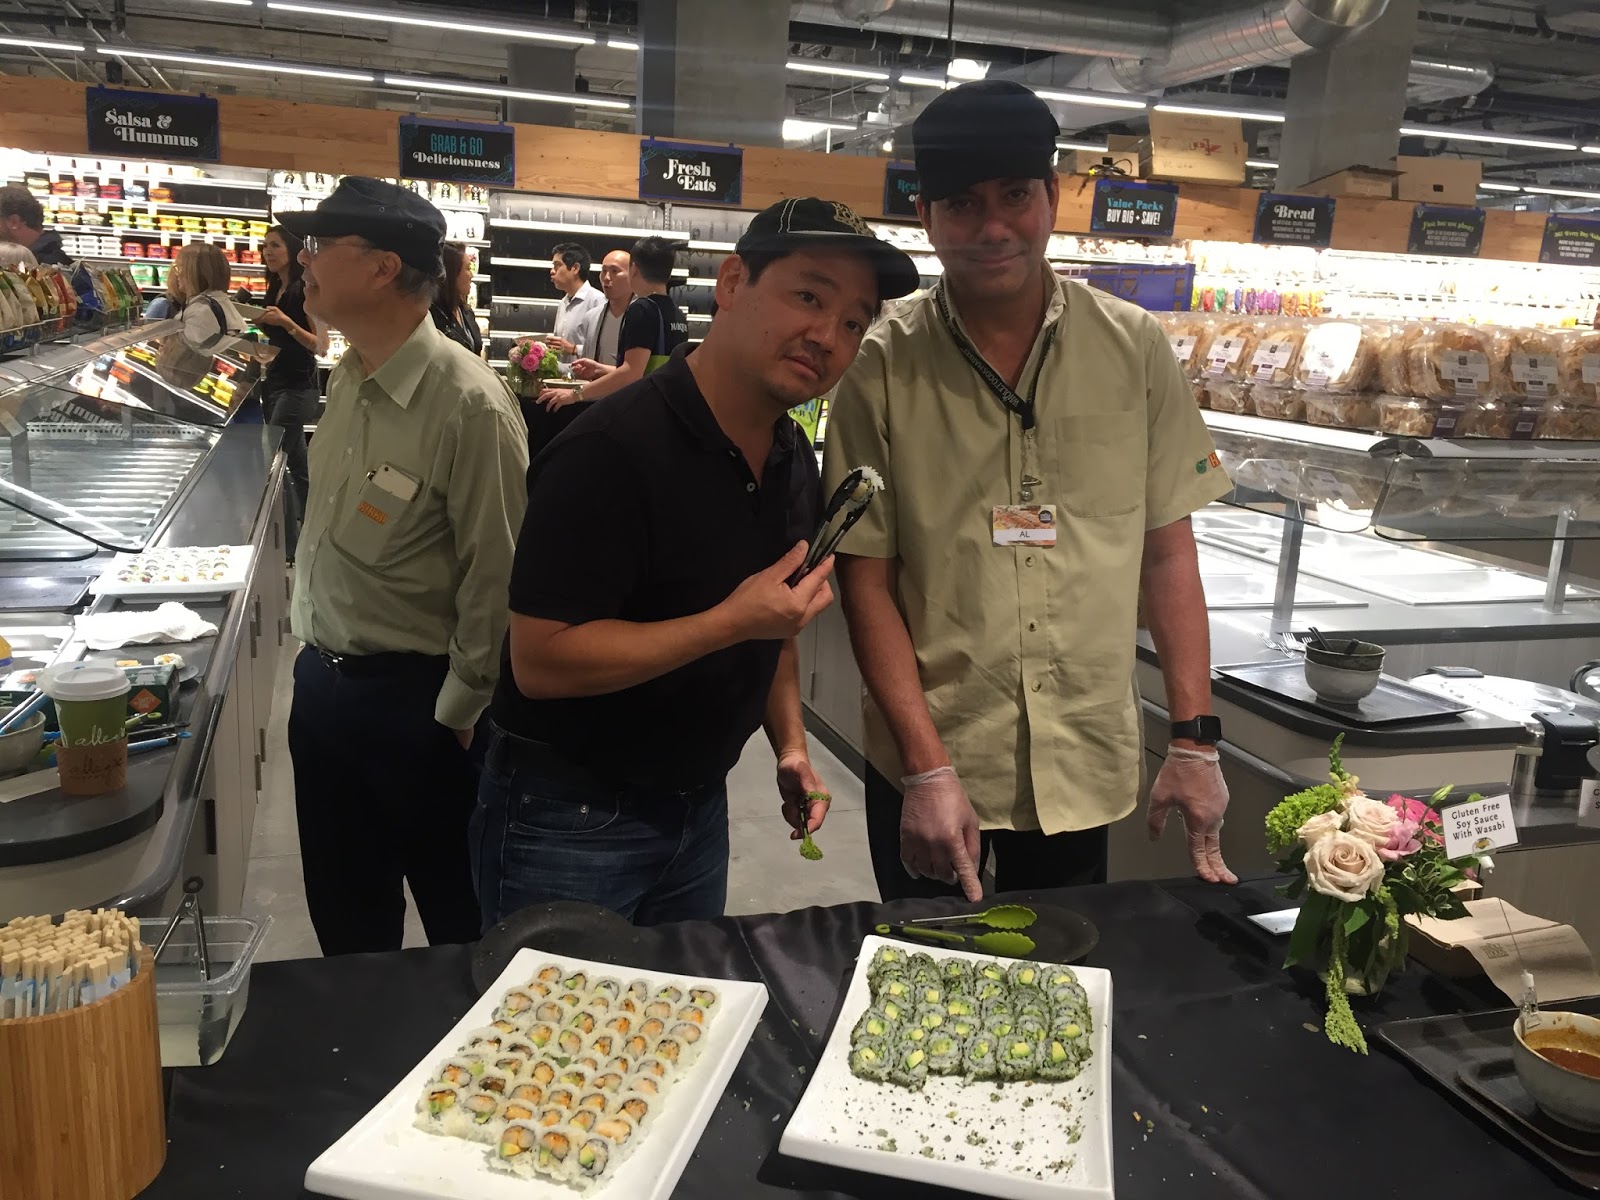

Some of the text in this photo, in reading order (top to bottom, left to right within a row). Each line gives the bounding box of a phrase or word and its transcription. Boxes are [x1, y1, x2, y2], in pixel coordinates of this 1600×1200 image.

[105, 108, 172, 129] Salsa &
[113, 126, 199, 147] Hummus
[430, 133, 483, 156] GRAB & GO
[412, 151, 500, 169] Deliciousness
[662, 158, 711, 180] Fresh
[677, 174, 717, 193] Eats
[1107, 197, 1164, 211] Value Packs
[1274, 204, 1316, 220] Bread
[1106, 208, 1121, 223] BUY
[1121, 209, 1135, 224] BIG
[1141, 210, 1161, 226] SAVE!
[1019, 530, 1031, 538] AL
[1451, 802, 1500, 820] Gluten Free
[1456, 813, 1499, 829] Soy Sauce
[1452, 821, 1506, 841] With Wasabi
